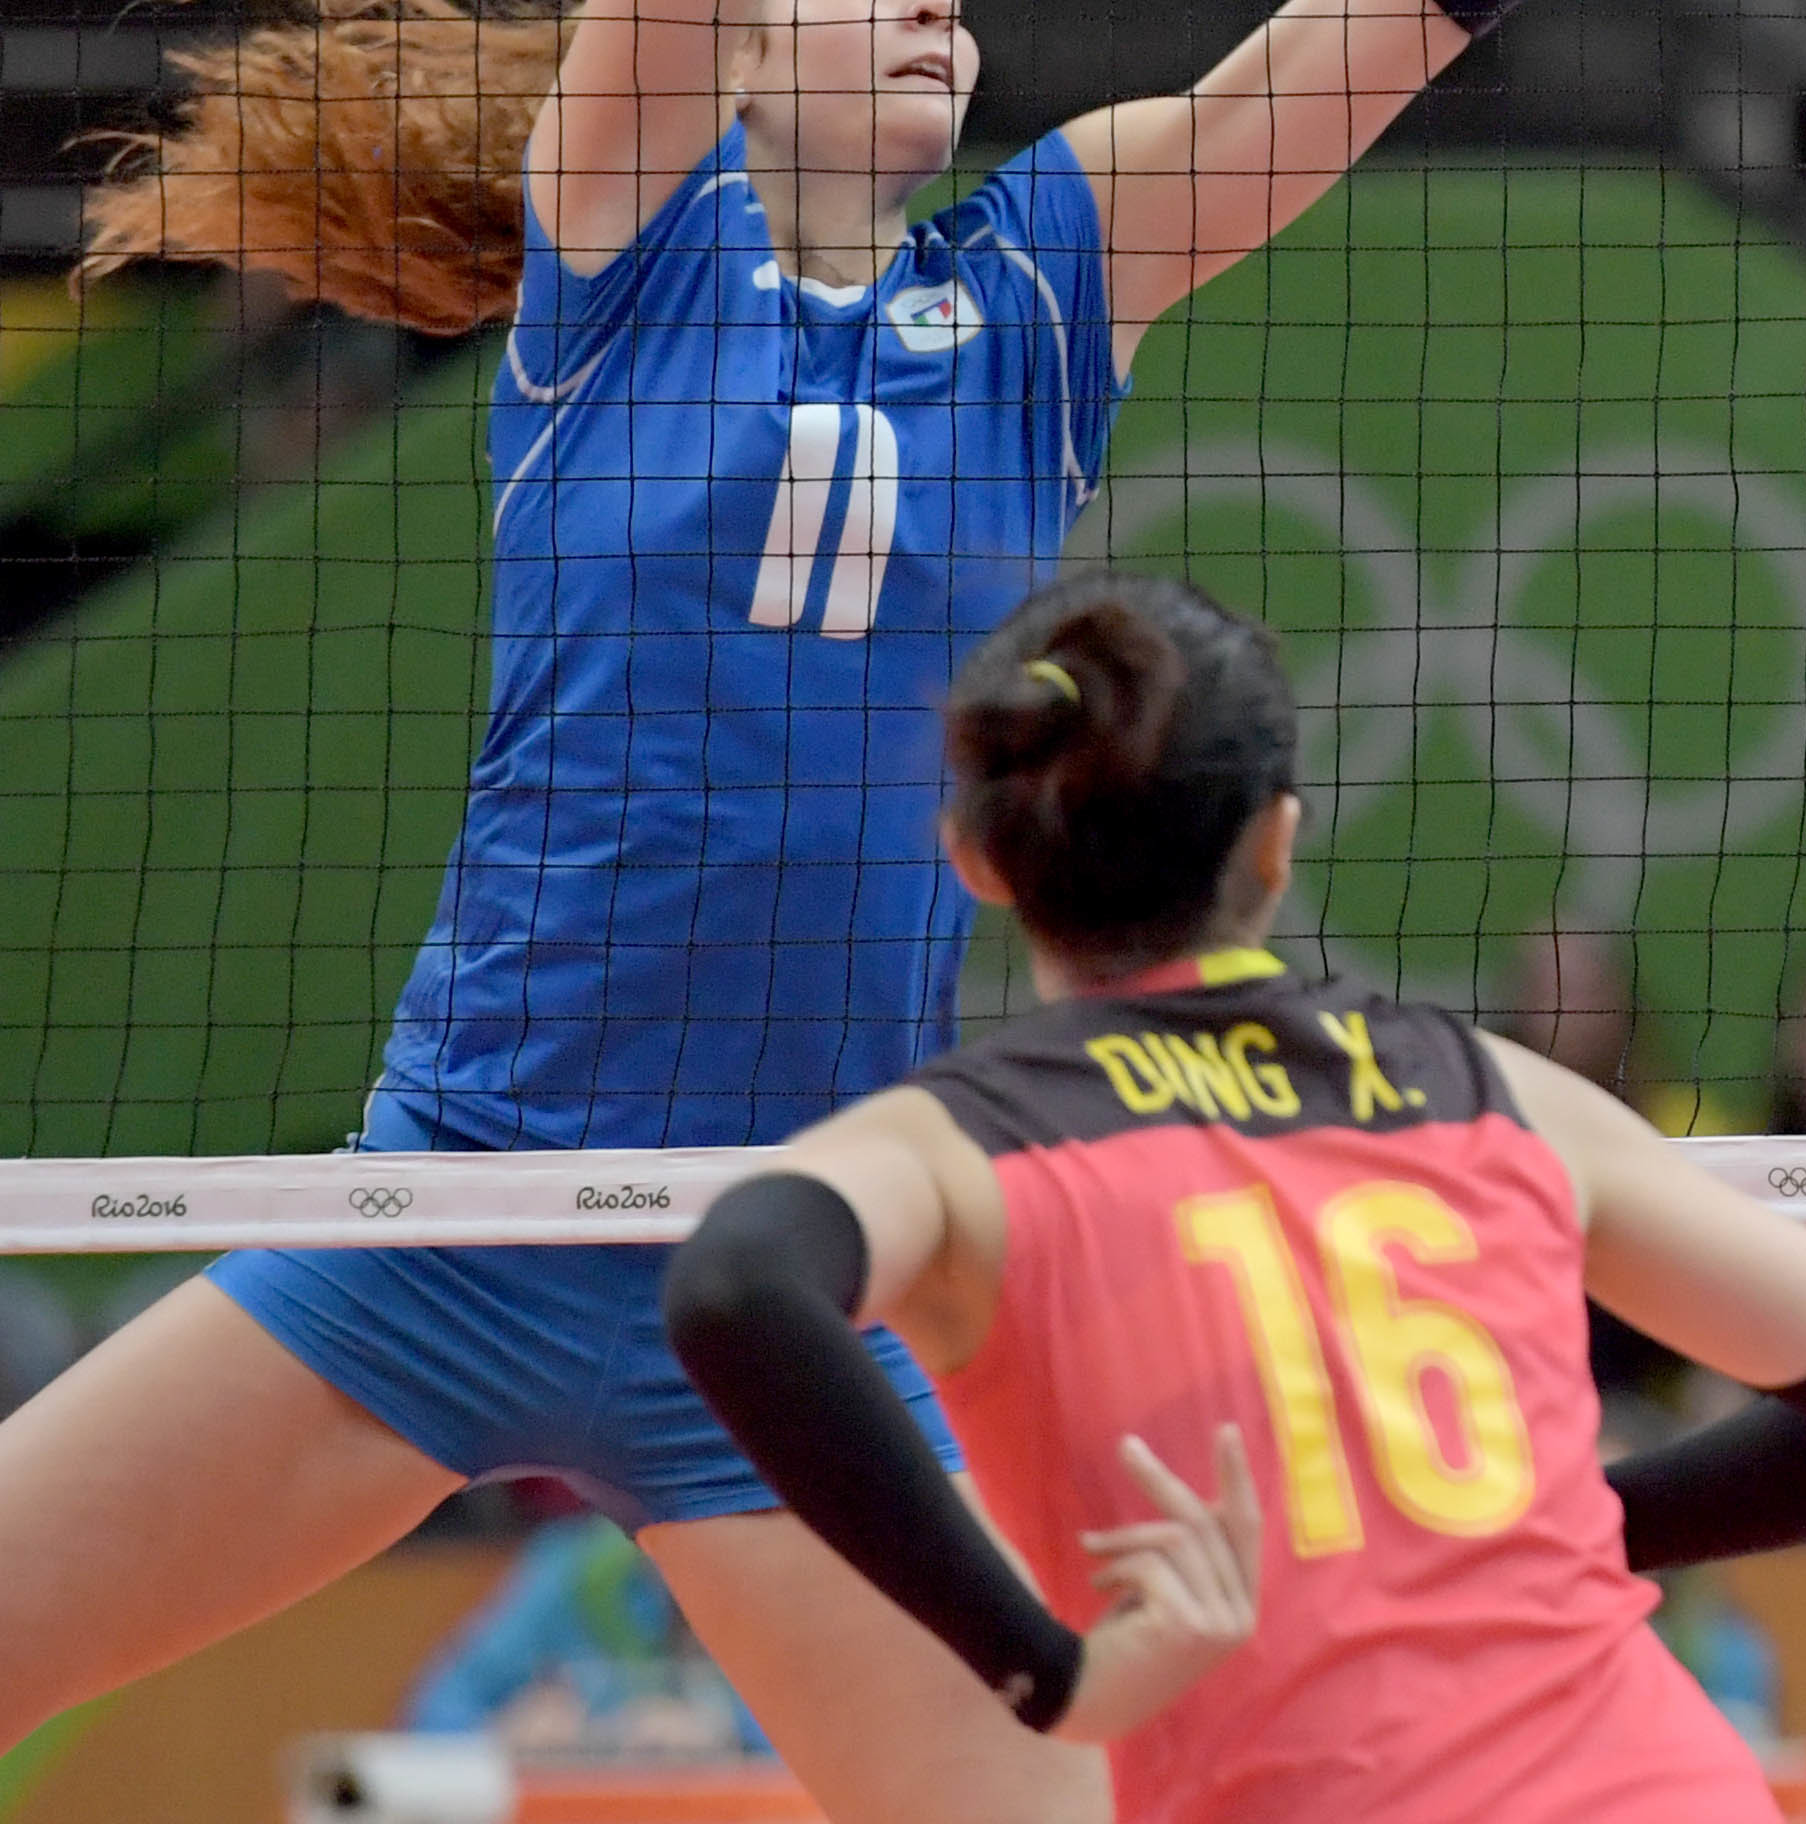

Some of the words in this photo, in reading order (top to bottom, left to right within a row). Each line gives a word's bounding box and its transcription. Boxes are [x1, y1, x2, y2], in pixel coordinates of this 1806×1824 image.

[748, 403, 899, 640] 11
[1085, 1022, 1301, 1122] DING
[1317, 1010, 1427, 1122] X.
[91, 1193, 188, 1219] Rio2016
[575, 1185, 671, 1212] Rio2016
[1173, 1178, 1537, 1560] 16
